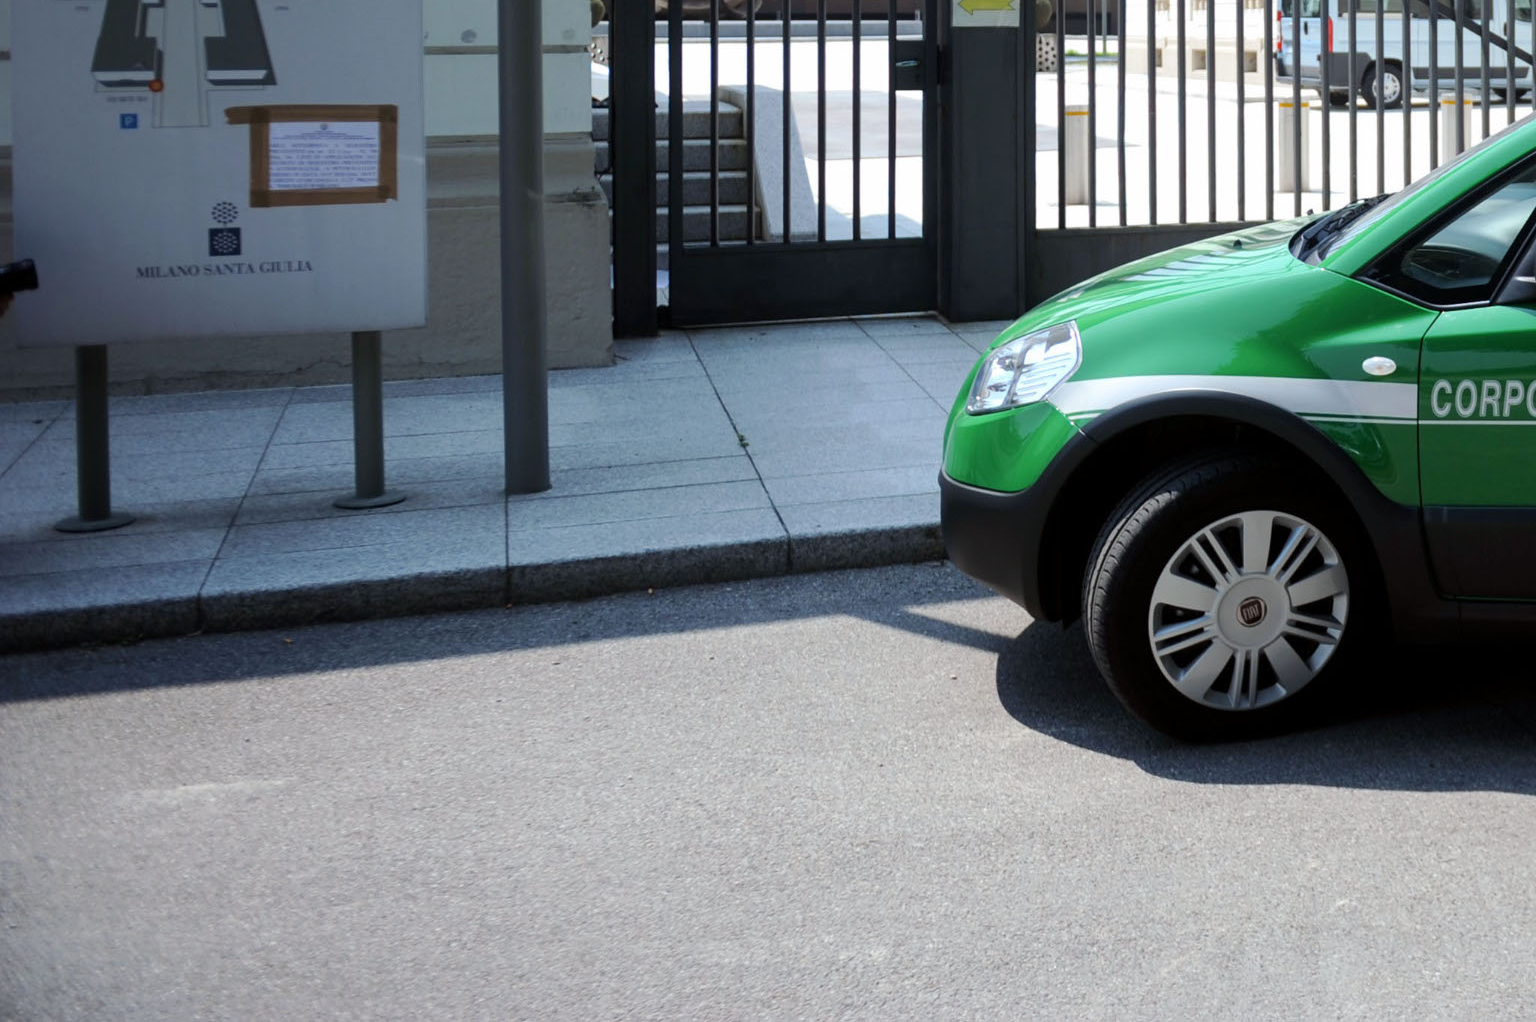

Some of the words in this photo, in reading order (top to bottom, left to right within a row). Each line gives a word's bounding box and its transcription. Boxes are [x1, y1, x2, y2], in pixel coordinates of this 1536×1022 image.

[136, 264, 200, 278] MILANO
[203, 262, 256, 276] SANTA
[259, 260, 313, 274] GIULIA
[1243, 604, 1260, 622] FIAT
